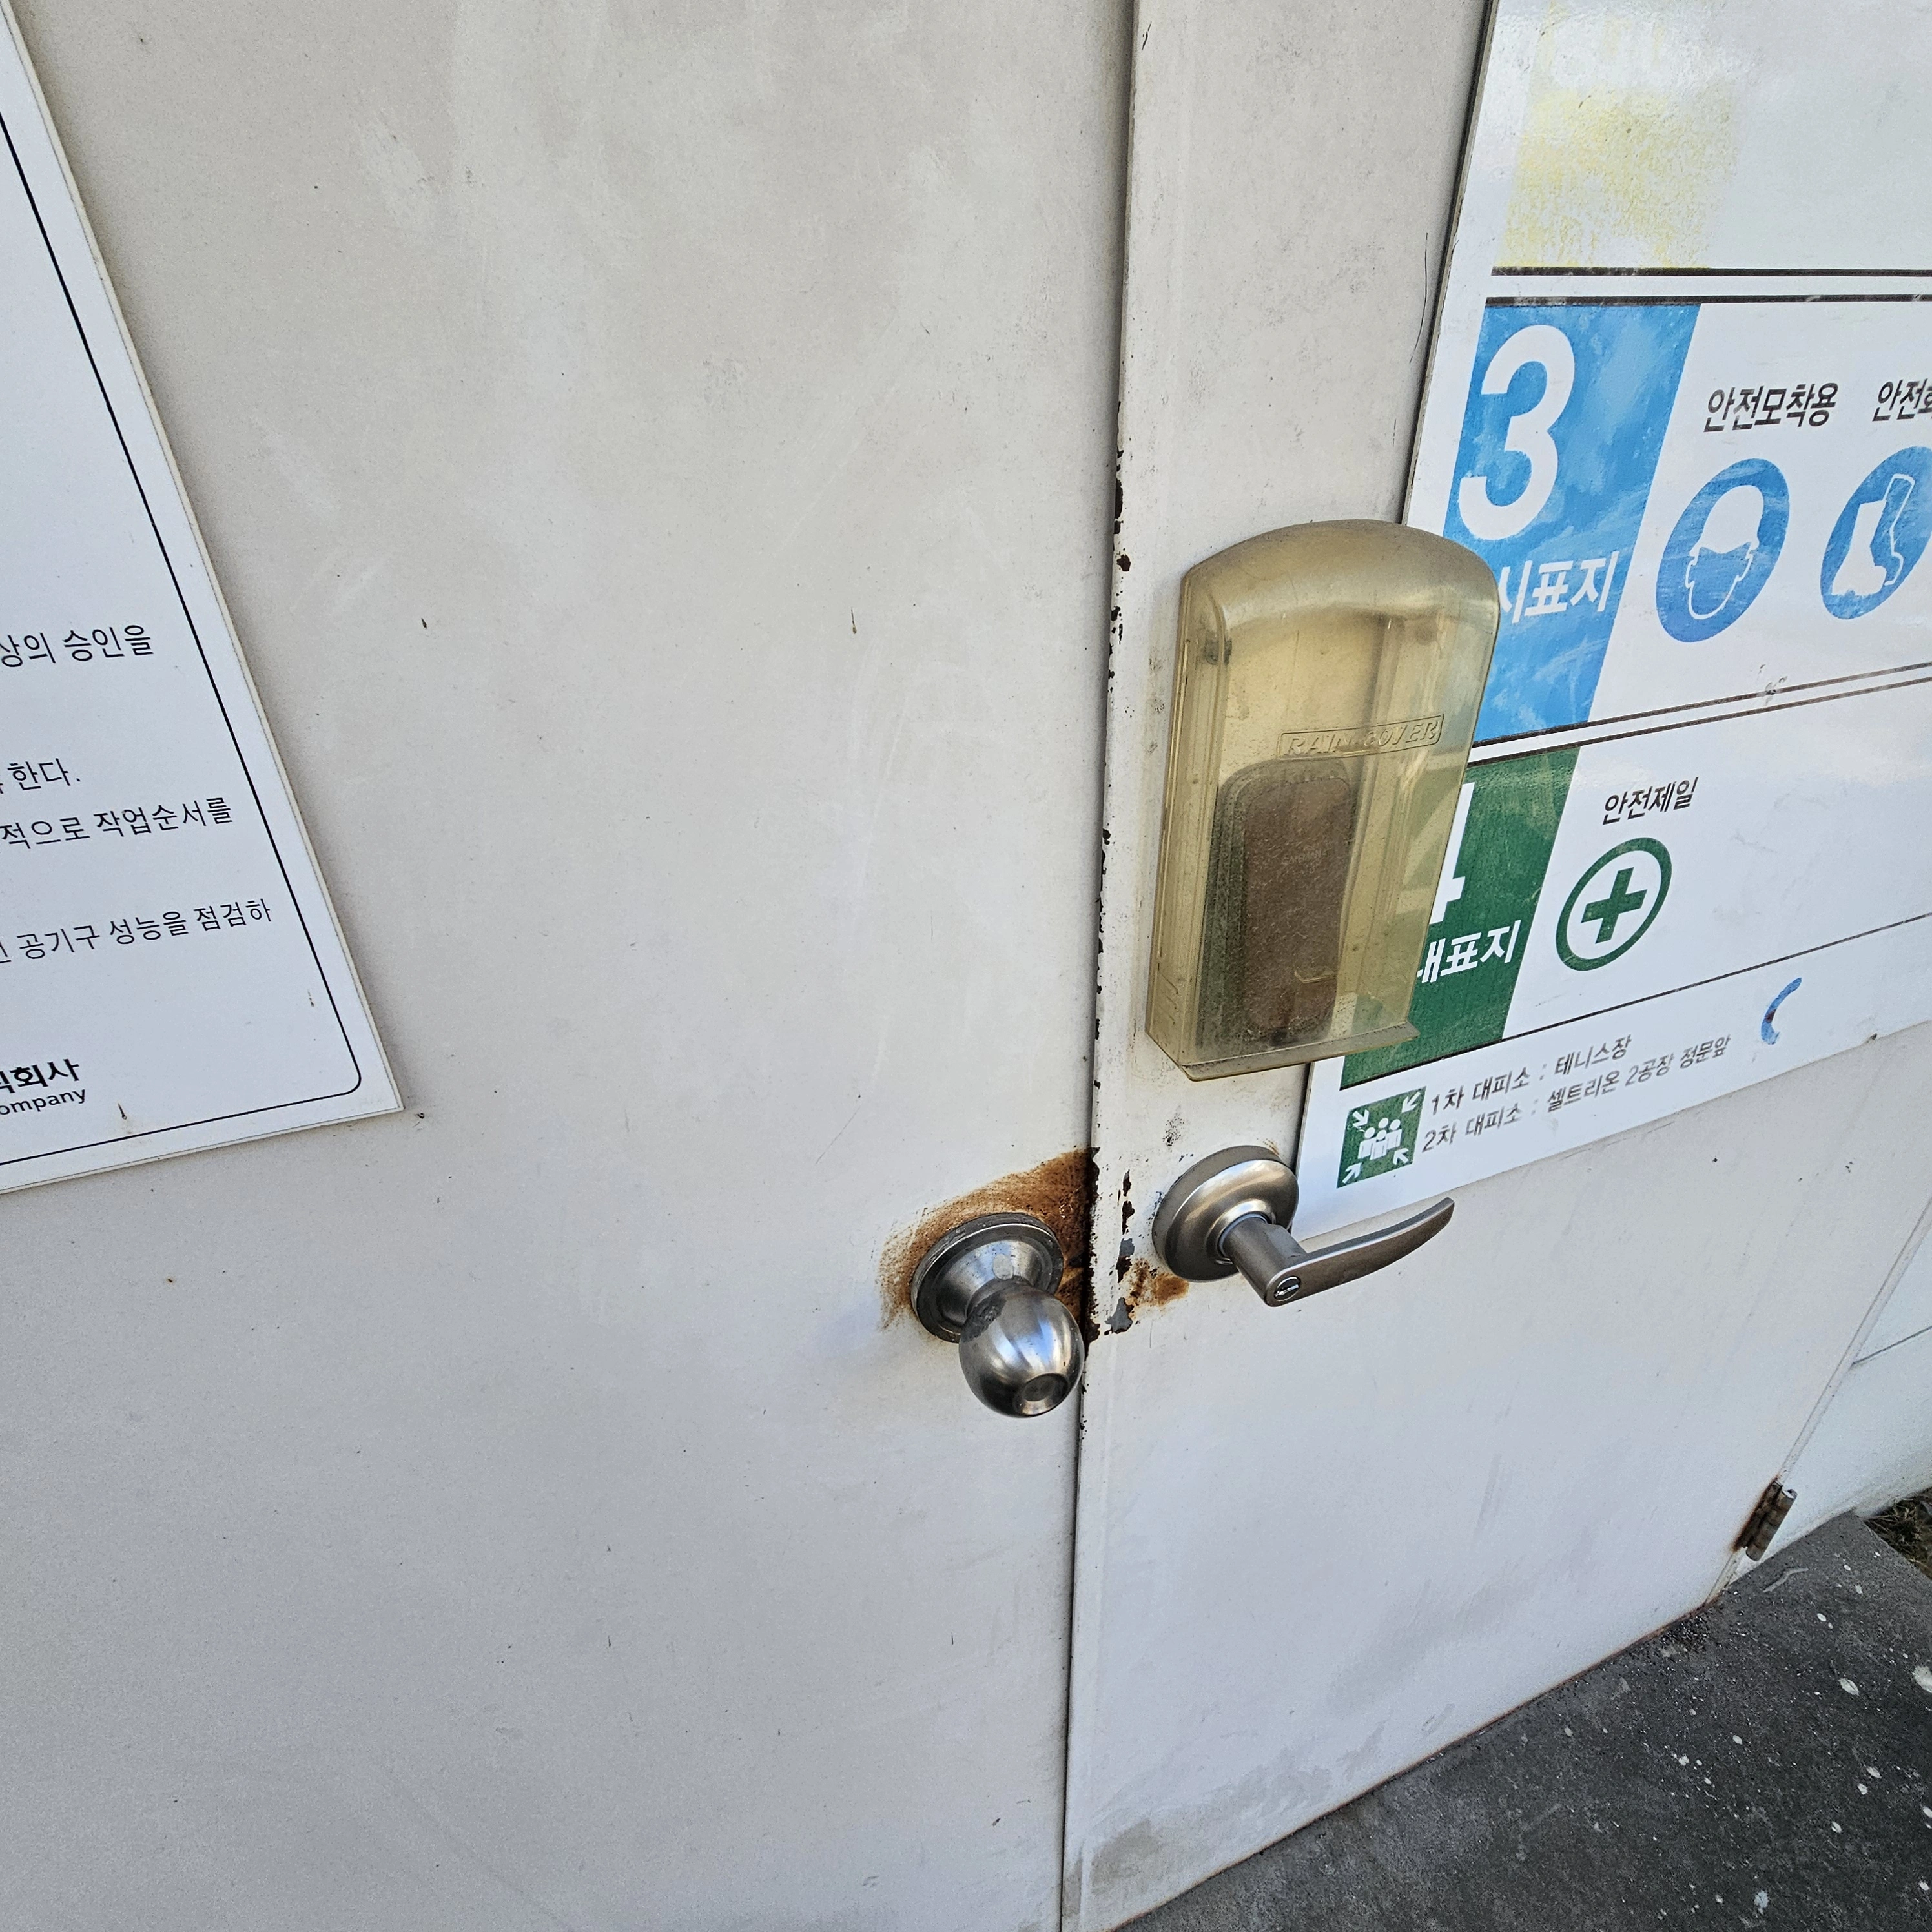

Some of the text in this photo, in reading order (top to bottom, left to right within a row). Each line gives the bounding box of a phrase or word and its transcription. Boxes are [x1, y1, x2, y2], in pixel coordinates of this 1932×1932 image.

[1458, 324, 1576, 540] 3
[1703, 382, 1839, 432] 안전모착용
[0, 625, 154, 667] 상의 승인을
[1284, 720, 1439, 757] RAIN COVER
[7, 758, 81, 790] 한다.
[0, 797, 233, 849] 적으로 작업순서를
[1602, 776, 1699, 825] 안전제일
[17, 925, 100, 960] 공기구
[109, 910, 189, 945] 성능을
[194, 898, 272, 932] 점검하
[1421, 1121, 1457, 1153] 2차
[1464, 1102, 1523, 1136] 대피소
[1547, 1070, 1621, 1113] 셀트리온
[1624, 1053, 1675, 1087] 2공장
[1680, 1033, 1732, 1070] 정문앞
[1432, 1085, 1465, 1116] 1차
[1472, 1066, 1531, 1102] 대피소
[1554, 1034, 1632, 1076] 테니스장
